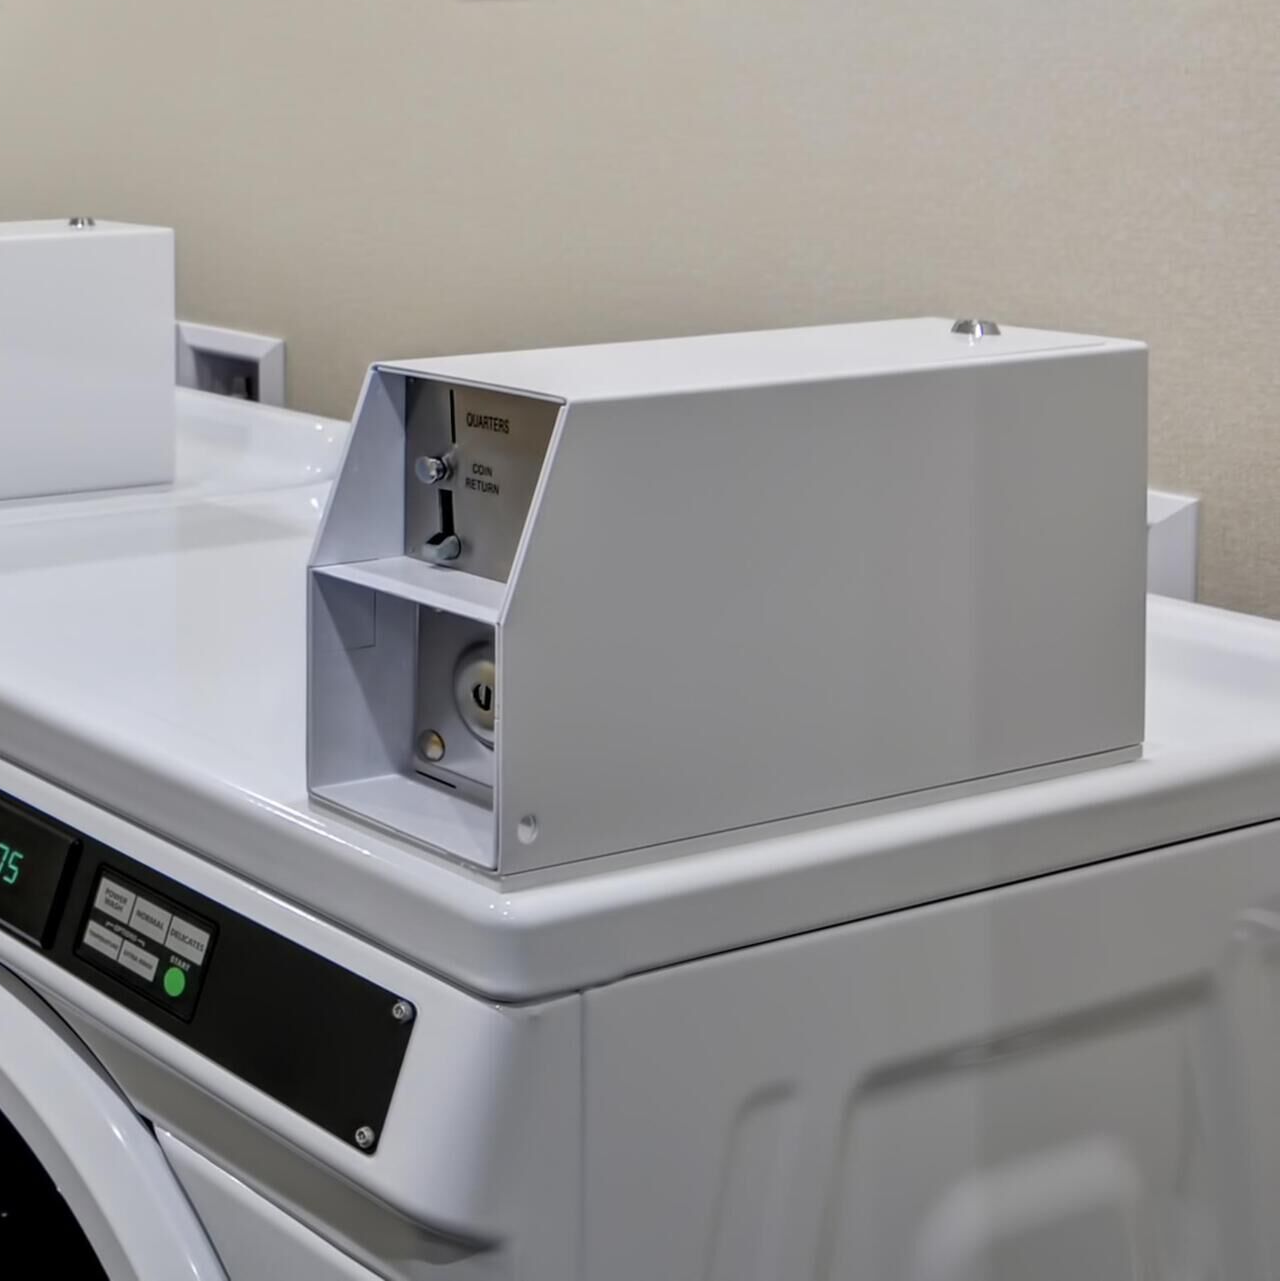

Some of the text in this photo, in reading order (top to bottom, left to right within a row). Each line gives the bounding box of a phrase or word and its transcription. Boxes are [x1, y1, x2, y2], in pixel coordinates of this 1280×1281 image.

[466, 412, 510, 434] QUARTERS
[472, 463, 493, 477] COIN
[465, 477, 500, 495] RETURN
[170, 928, 205, 953] DELICATES
